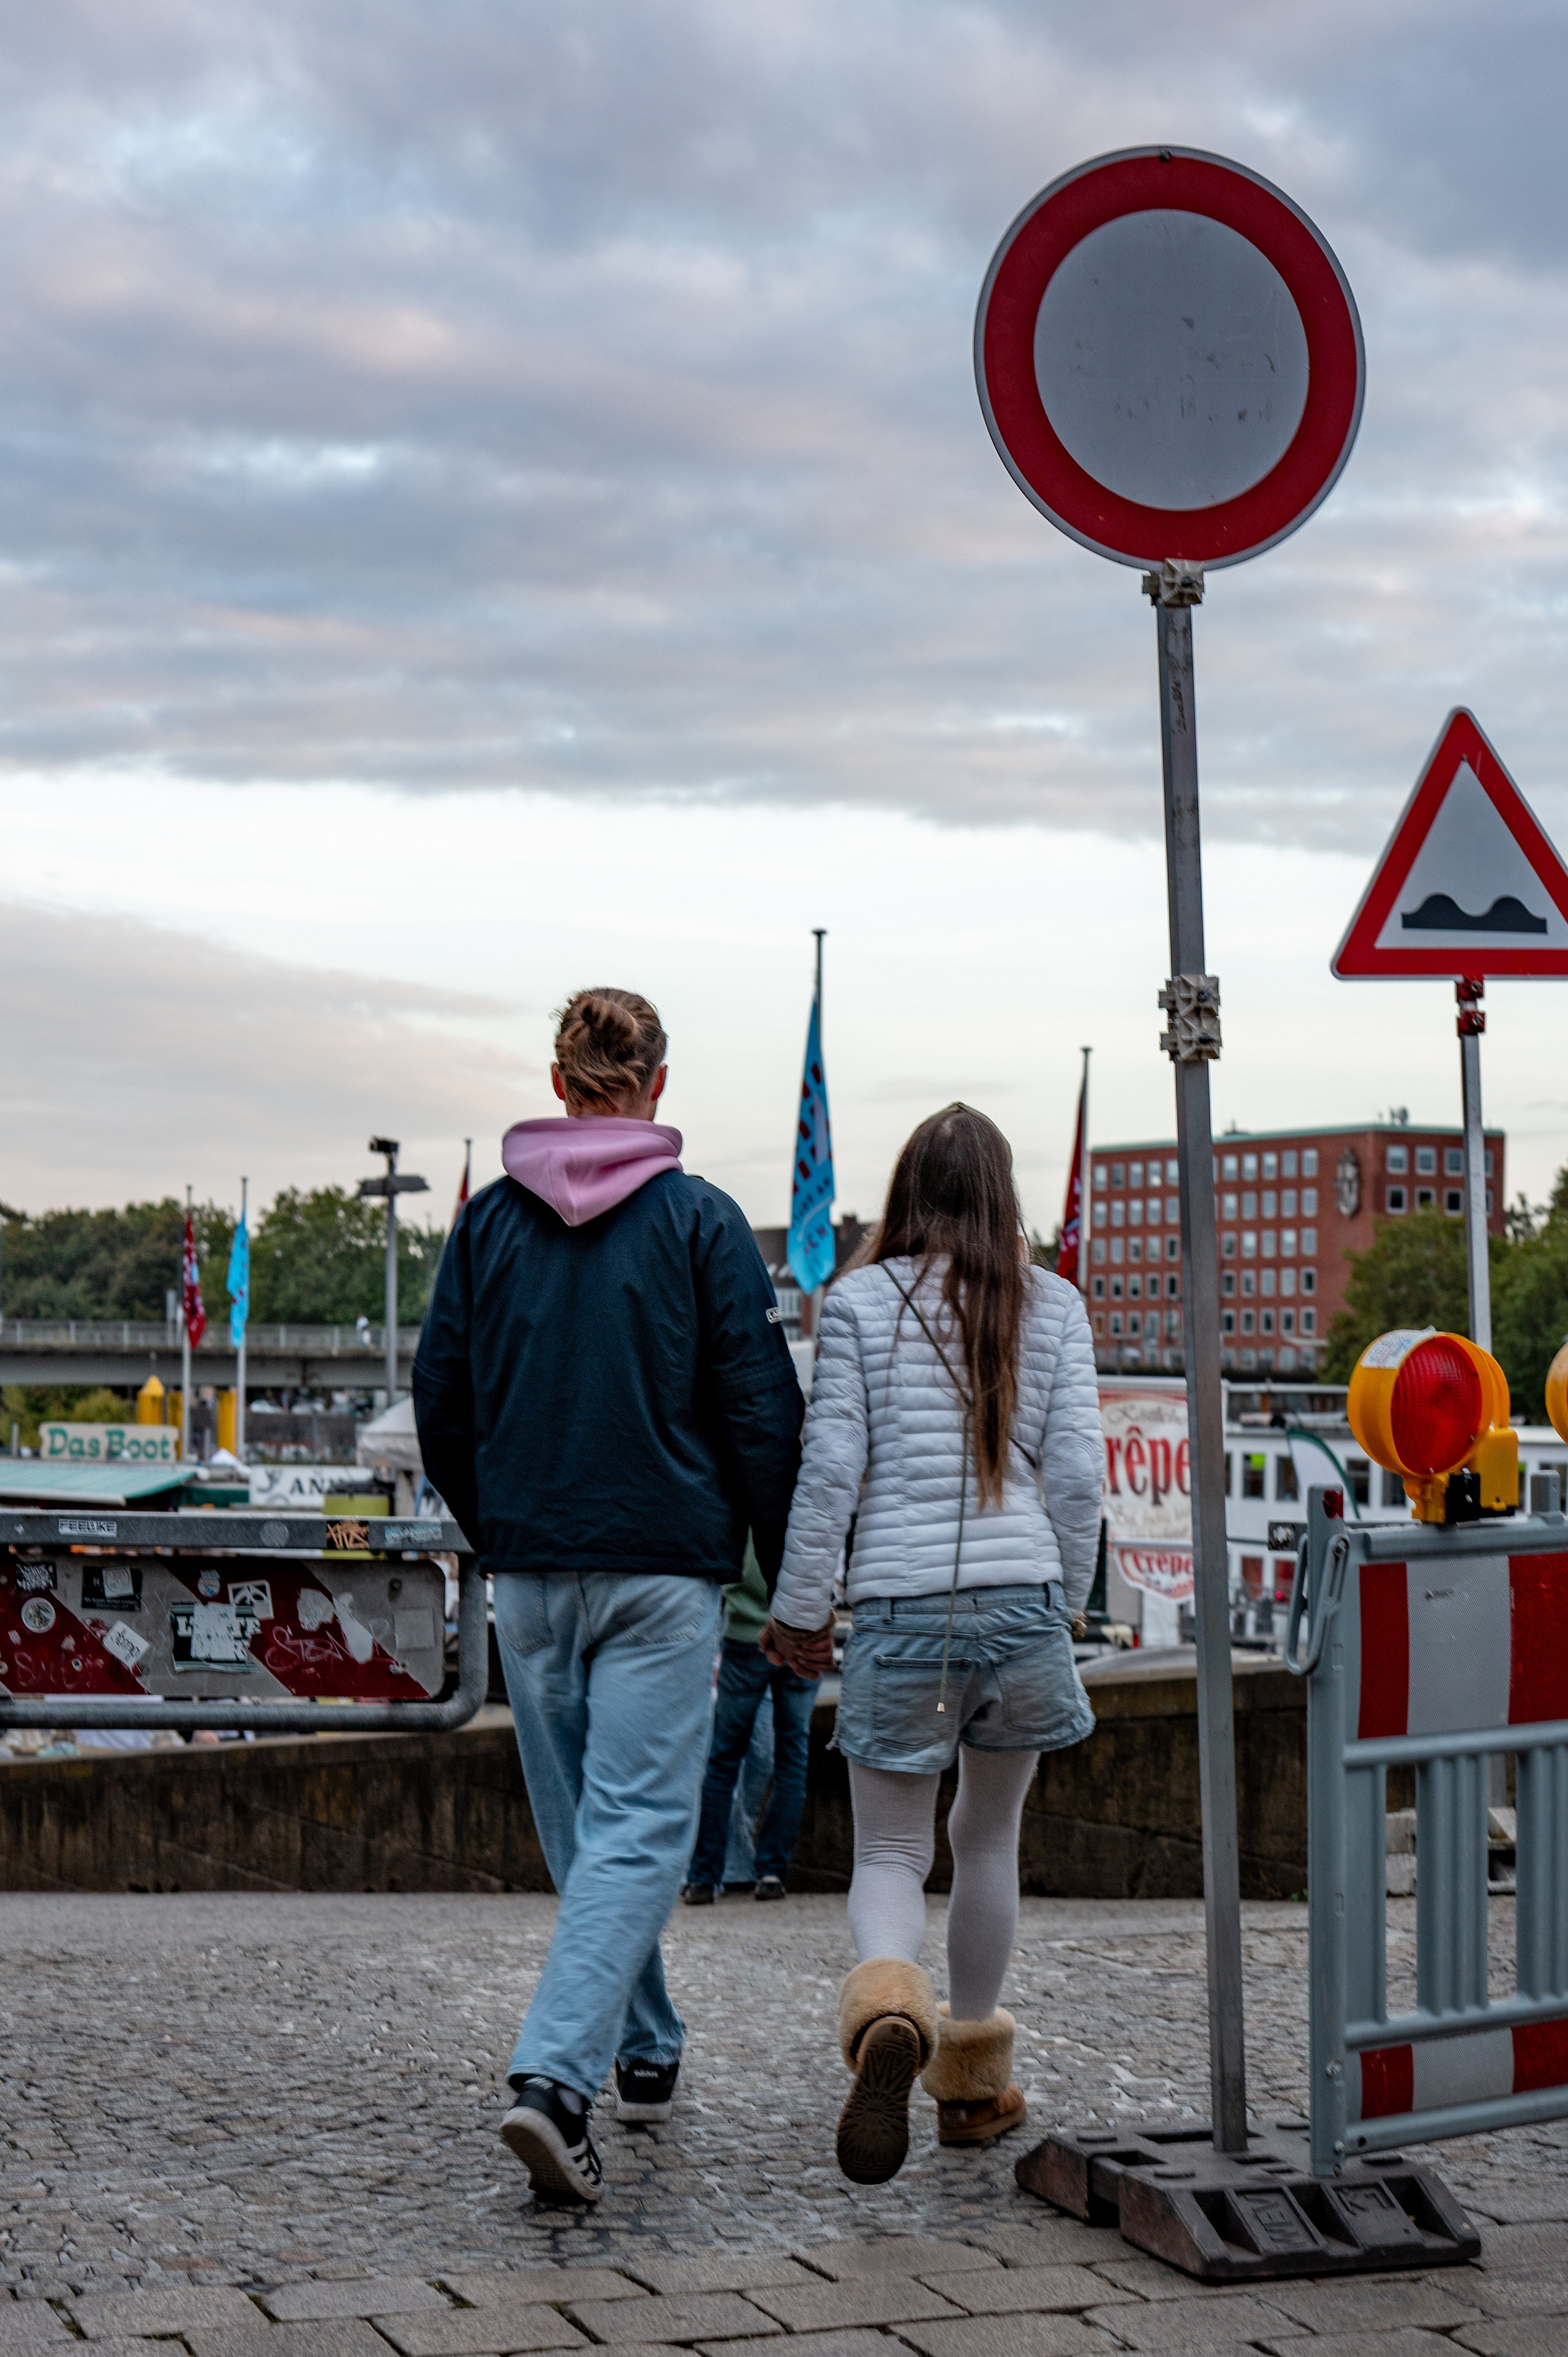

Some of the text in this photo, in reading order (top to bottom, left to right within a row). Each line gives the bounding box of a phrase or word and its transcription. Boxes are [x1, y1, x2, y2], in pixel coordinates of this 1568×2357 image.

[48, 1426, 170, 1459] Das Boot
[1102, 1425, 1191, 1506] rêpe
